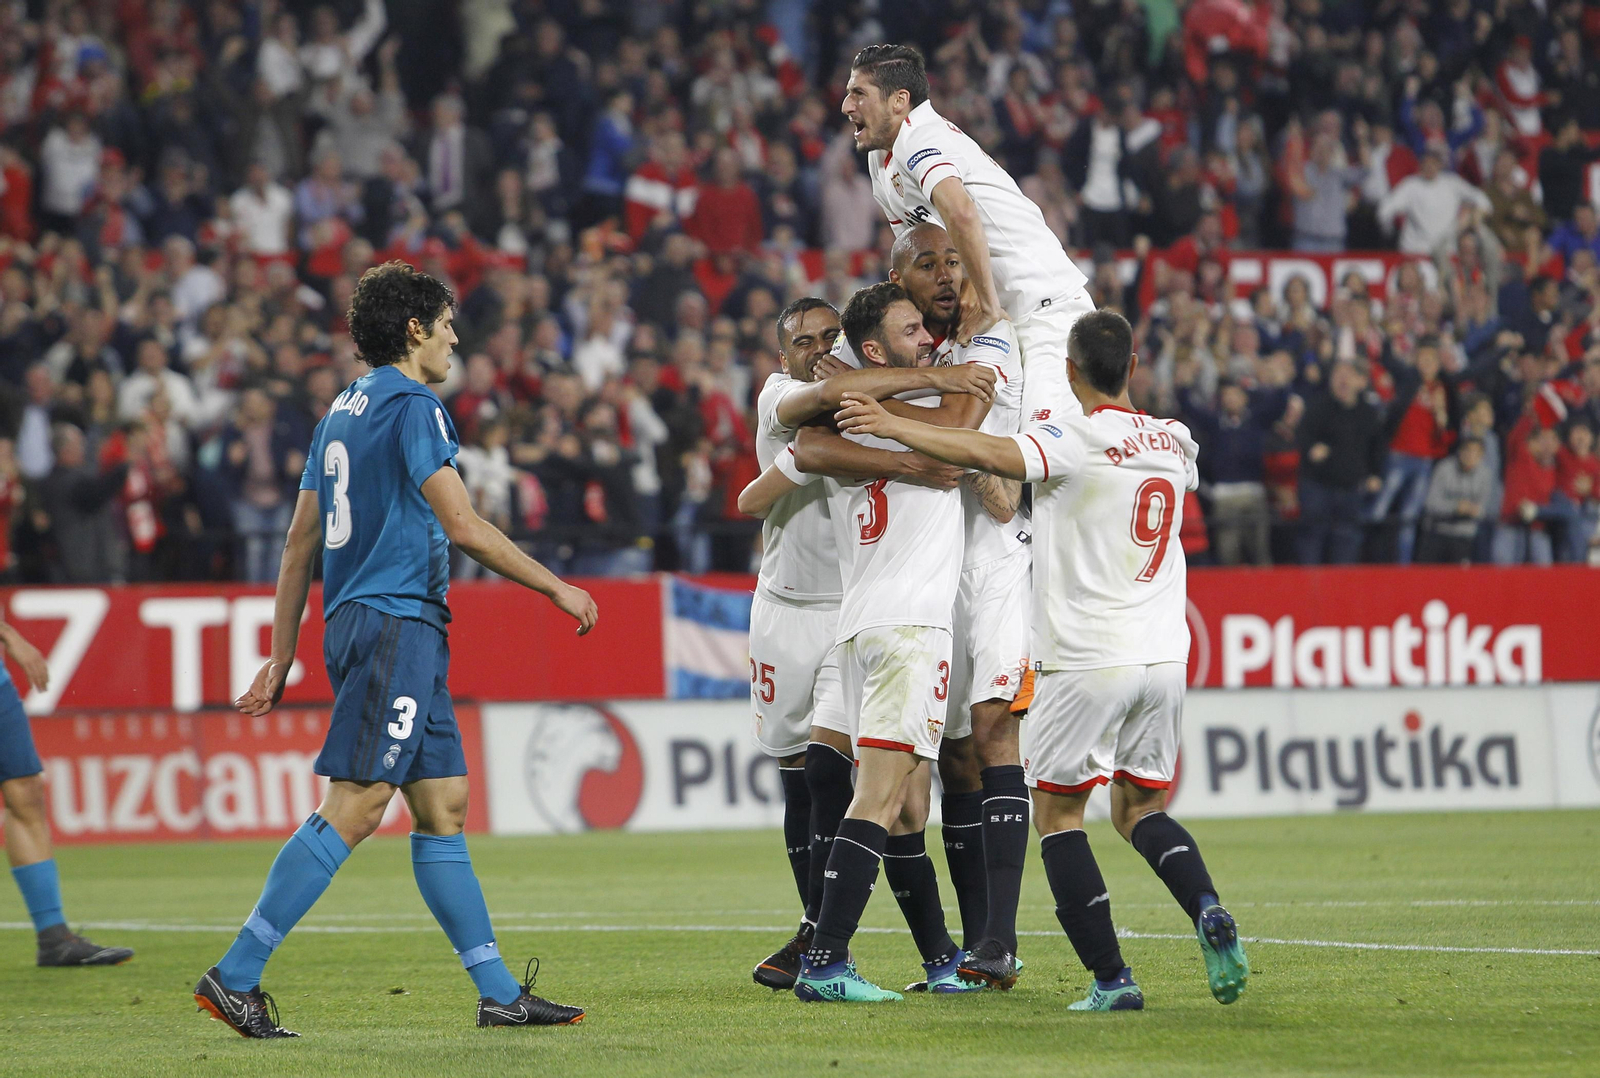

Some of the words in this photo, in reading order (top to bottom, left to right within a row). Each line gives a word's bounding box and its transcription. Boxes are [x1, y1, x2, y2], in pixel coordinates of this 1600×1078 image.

[324, 439, 353, 550] 3
[1130, 476, 1177, 583] 9
[387, 695, 418, 740] 3
[932, 660, 950, 703] 3
[1205, 708, 1521, 811] Playtika
